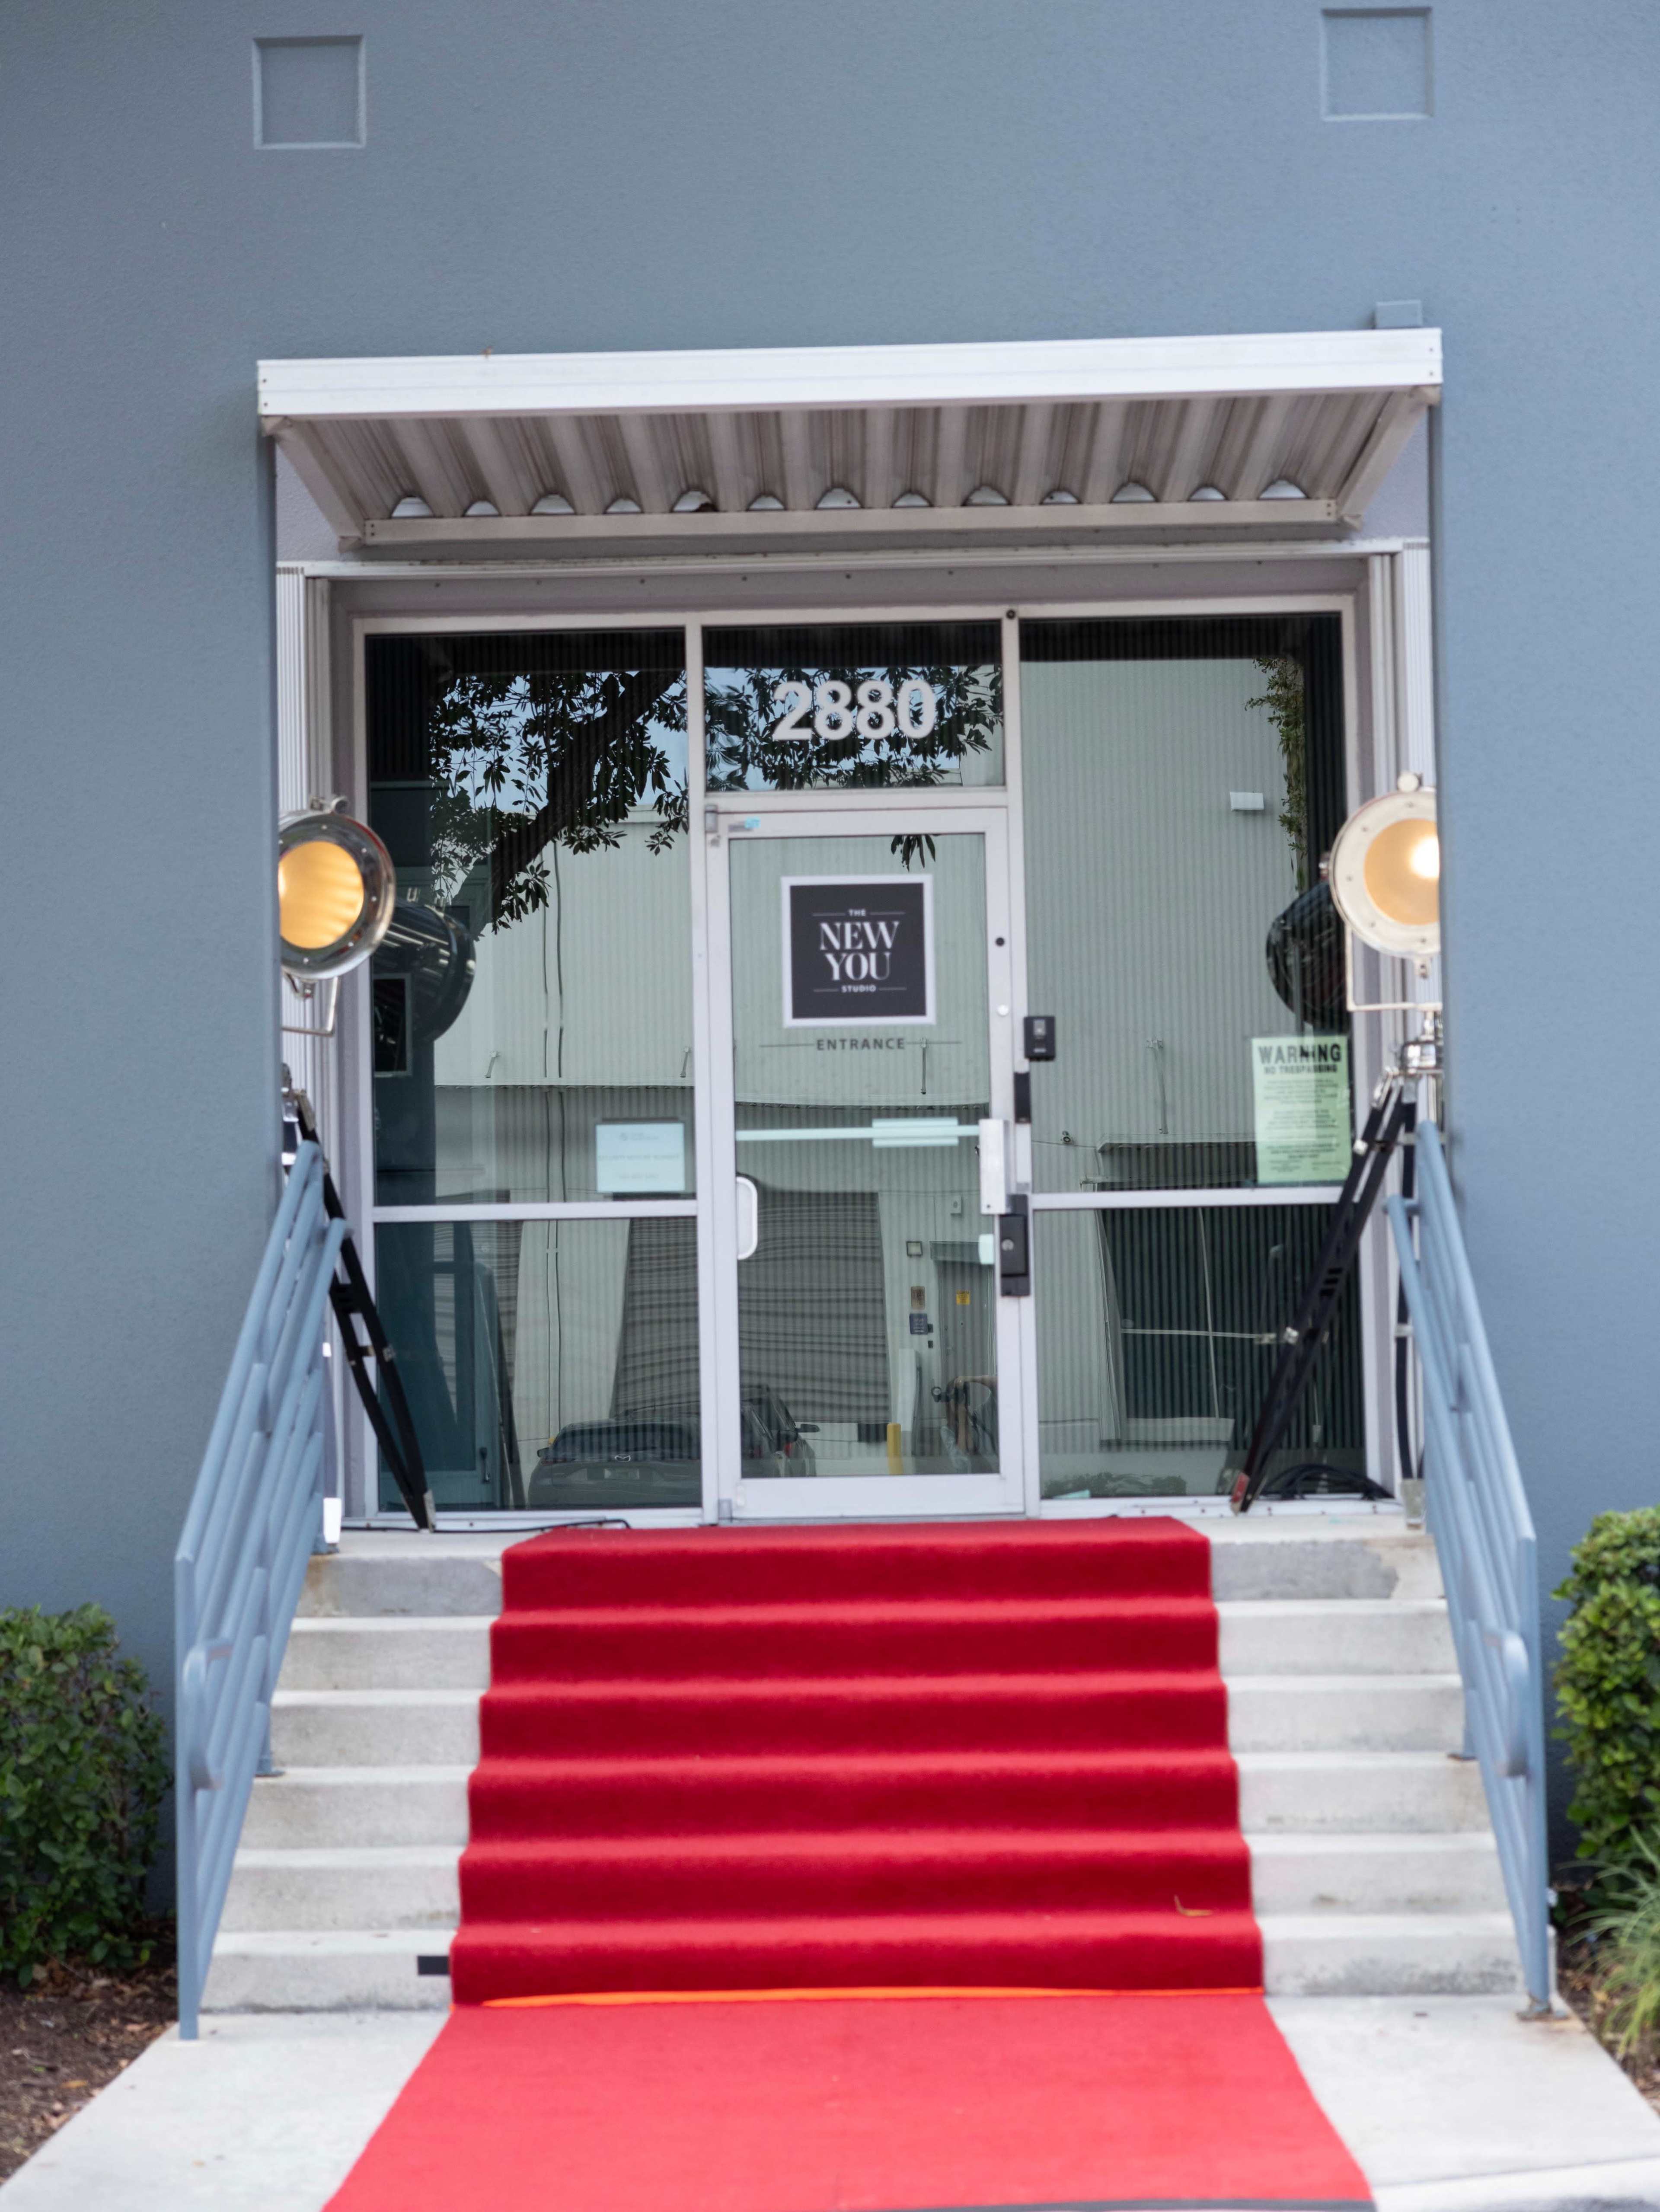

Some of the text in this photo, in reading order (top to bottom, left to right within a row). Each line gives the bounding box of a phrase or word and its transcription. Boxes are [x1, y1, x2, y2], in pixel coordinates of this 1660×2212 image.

[773, 680, 935, 741] 2880
[820, 921, 900, 950] NEW
[824, 952, 891, 981] YOU
[817, 1038, 905, 1050] ENTRANCE
[1258, 1044, 1342, 1064] WARNING
[1264, 1064, 1338, 1074] NO TRESPASSING
